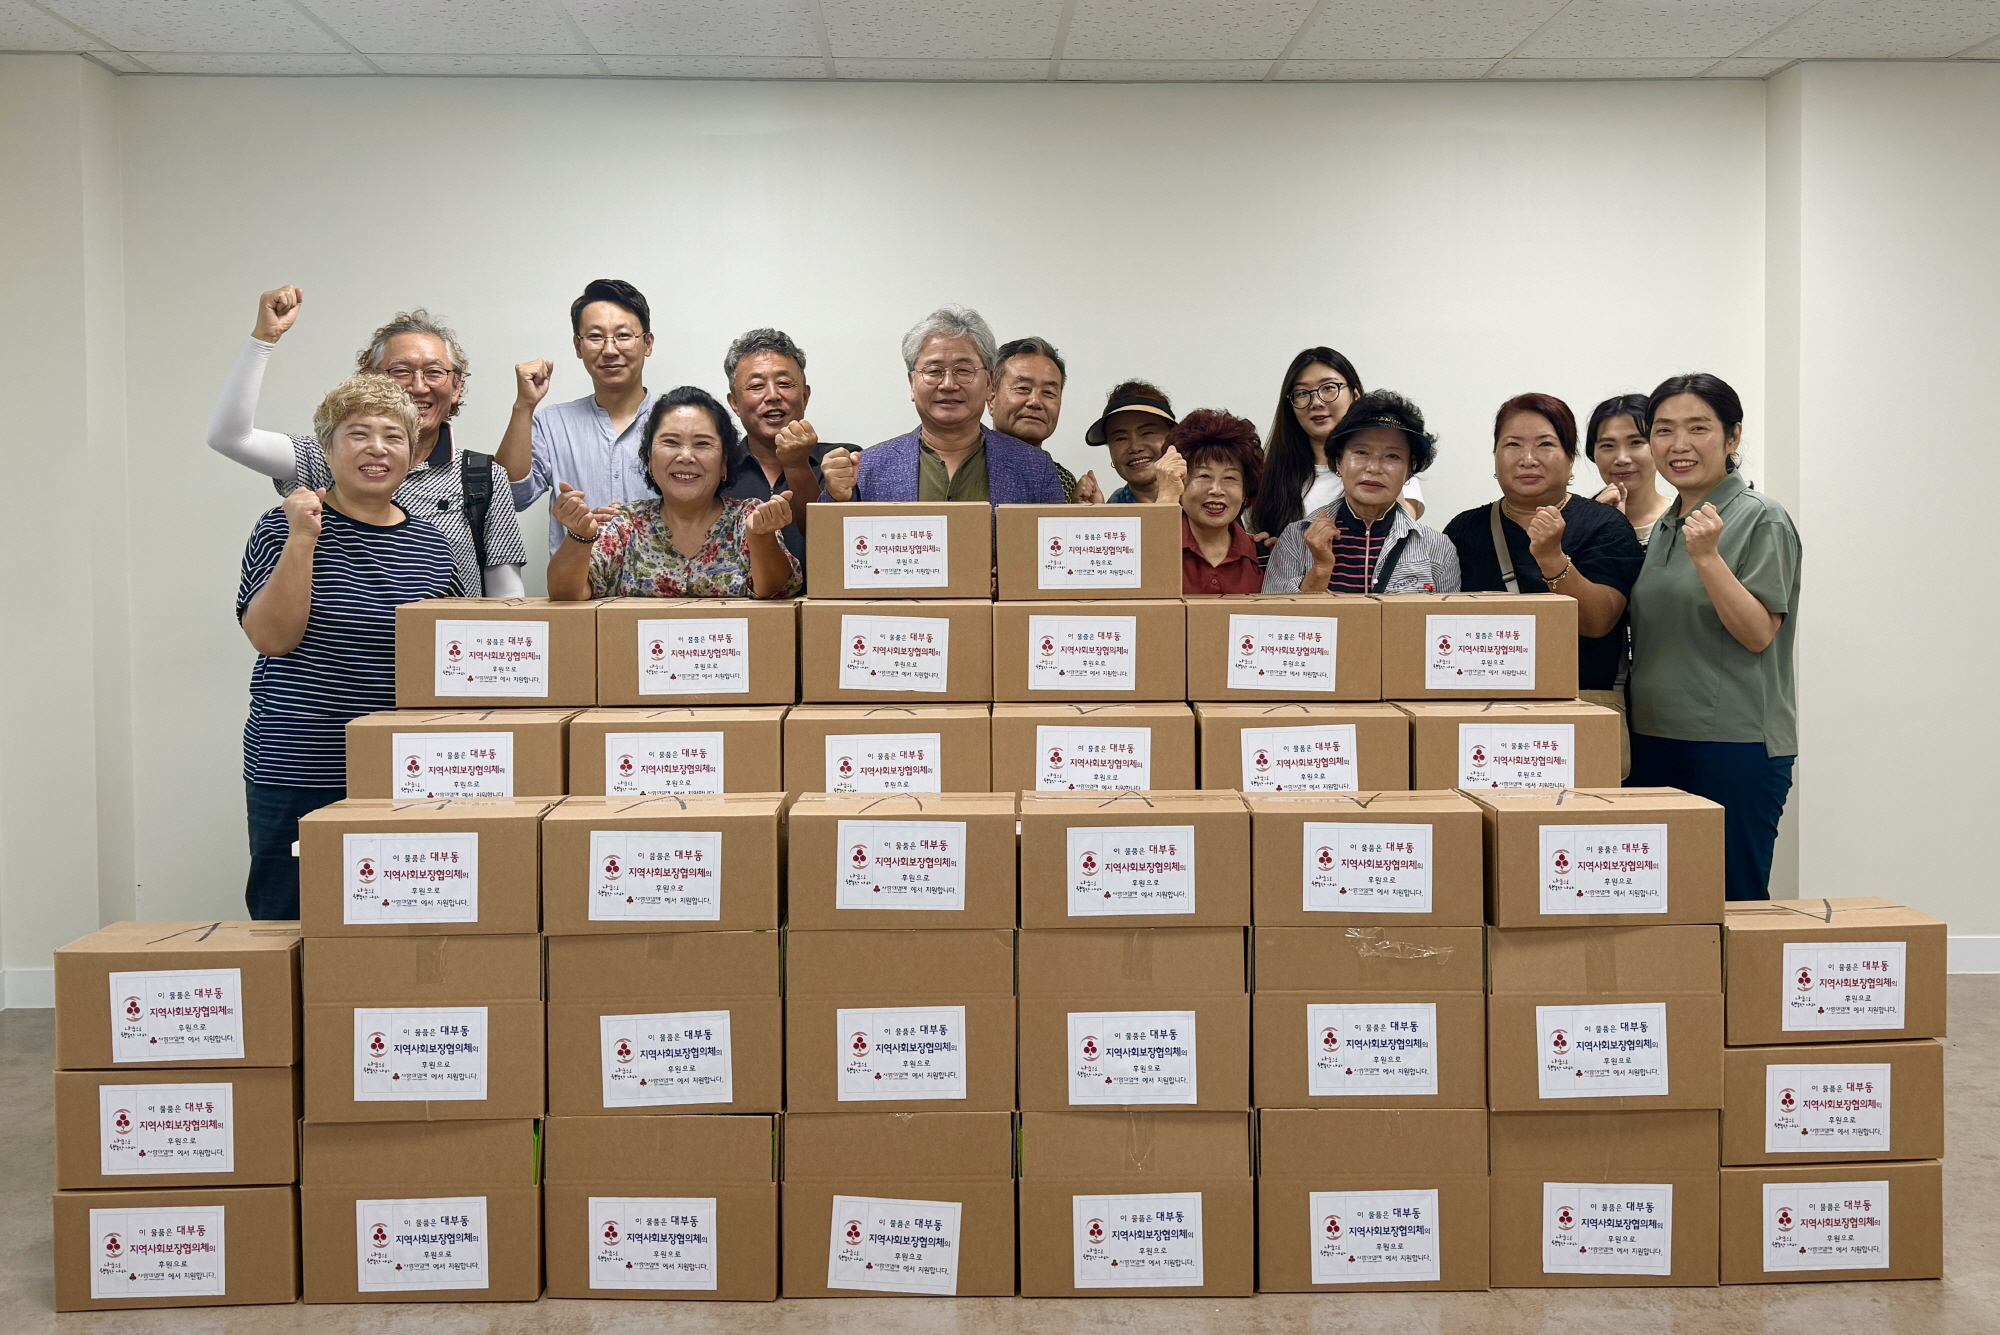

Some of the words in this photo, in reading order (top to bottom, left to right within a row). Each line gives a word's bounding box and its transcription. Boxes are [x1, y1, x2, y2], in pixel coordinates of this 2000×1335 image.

[910, 530, 934, 540] 대부동
[1103, 531, 1127, 541] 대부동
[874, 544, 941, 555] 지역사회보장협의체의
[1068, 545, 1134, 556] 지역사회보장협의체의
[895, 558, 920, 566] 후원으로
[1089, 559, 1113, 567] 후원으로
[507, 636, 533, 647] 대부동
[708, 633, 733, 644] 대부동
[909, 632, 934, 643] 대부동
[1097, 631, 1122, 642] 대부동
[1298, 631, 1323, 642] 대부동
[1495, 630, 1521, 641] 대부동
[468, 650, 541, 662] 지역사회보장협의체의
[670, 648, 741, 660] 지역사회보장협의체의
[871, 646, 941, 658] 지역사회보장협의체의
[1060, 645, 1129, 656] 지역사회보장협의체의
[1260, 645, 1330, 657] 지역사회보장협의체의
[1457, 644, 1529, 656] 지역사회보장협의체의
[693, 662, 719, 671] 후원으로
[893, 660, 918, 669] 후원으로
[1082, 660, 1106, 668] 후원으로
[1281, 660, 1306, 668] 후원으로
[1480, 659, 1505, 667] 후원으로
[491, 666, 517, 674] 후원으로
[1109, 743, 1135, 754] 대부동
[1314, 741, 1341, 752] 대부동
[1532, 740, 1559, 751] 대부동
[469, 748, 497, 760] 대부동
[681, 748, 708, 759] 대부동
[899, 749, 925, 761] 대부동
[1069, 758, 1143, 770] 지역사회보장협의체의
[1275, 756, 1350, 770] 지역사회보장협의체의
[1492, 755, 1567, 767] 지역사회보장협의체의
[428, 764, 506, 777] 지역사회보장협의체의
[640, 763, 716, 776] 지역사회보장협의체의
[859, 765, 933, 777] 지역사회보장협의체의
[1516, 771, 1543, 779] 후원으로
[1093, 773, 1119, 782] 후원으로
[1300, 772, 1326, 781] 후원으로
[453, 780, 480, 789] 후원으로
[665, 779, 692, 788] 후원으로
[884, 780, 910, 789] 후원으로
[919, 839, 949, 852] 대부동
[1148, 844, 1178, 856] 대부동
[1349, 843, 1357, 851] 이
[1361, 843, 1383, 853] 물품은
[1385, 841, 1415, 854] 대부동
[1621, 842, 1650, 855] 대부동
[392, 854, 400, 862] 이
[404, 853, 427, 863] 물품은
[429, 851, 460, 864] 대부동
[674, 849, 704, 862] 대부동
[874, 856, 957, 869] 지역사회보장협의체의
[1104, 861, 1187, 875] 지역사회보장협의체의
[1340, 858, 1424, 872] 지역사회보장협의체의
[1577, 859, 1659, 873] 지역사회보장협의체의
[383, 869, 469, 882] 지역사회보장협의체의
[628, 866, 712, 880] 지역사회보장협의체의
[900, 873, 931, 883] 후원으로
[1131, 879, 1160, 888] 후원으로
[1367, 876, 1397, 885] 후원으로
[1604, 877, 1633, 887] 후원으로
[410, 887, 441, 896] 후원으로
[655, 884, 685, 894] 후원으로
[1376, 888, 1390, 896] 에서
[420, 899, 434, 907] 에서
[1862, 960, 1889, 972] 대부동
[1818, 977, 1898, 990] 지역사회보장협의체의
[168, 990, 191, 1001] 물품은
[194, 987, 224, 1000] 대부동
[1844, 994, 1872, 1004] 후원으로
[149, 1005, 234, 1019] 지역사회보장협의체의
[177, 1023, 207, 1033] 후원으로
[440, 1025, 470, 1038] 대부동
[919, 1024, 949, 1037] 대부동
[1365, 1023, 1387, 1033] 물품은
[1389, 1020, 1419, 1033] 대부동
[1620, 1021, 1649, 1033] 대부동
[683, 1028, 713, 1041] 대부동
[1149, 1028, 1178, 1041] 대부동
[393, 1041, 479, 1056] 지역사회보장협의체의
[875, 1041, 958, 1056] 지역사회보장협의체의
[1345, 1036, 1429, 1051] 지역사회보장협의체의
[1575, 1038, 1659, 1053] 지역사회보장협의체의
[639, 1046, 723, 1061] 지역사회보장협의체의
[1105, 1045, 1188, 1060] 지역사회보장협의체의
[421, 1060, 451, 1070] 후원으로
[901, 1059, 931, 1069] 후원으로
[1372, 1055, 1402, 1065] 후원으로
[1603, 1056, 1632, 1066] 후원으로
[667, 1064, 697, 1074] 후원으로
[1132, 1064, 1161, 1074] 후원으로
[1382, 1068, 1395, 1076] 에서
[1846, 1081, 1874, 1094] 대부동
[184, 1101, 215, 1114] 대부동
[1802, 1099, 1882, 1111] 지역사회보장협의체의
[139, 1119, 224, 1133] 지역사회보장협의체의
[1828, 1116, 1857, 1125] 후원으로
[166, 1137, 197, 1146] 후원으로
[1625, 1201, 1655, 1214] 대부동
[1808, 1203, 1816, 1211] 이
[1819, 1202, 1841, 1212] 물품은
[1843, 1199, 1872, 1211] 대부동
[1155, 1211, 1185, 1224] 대부동
[1392, 1207, 1422, 1220] 대부동
[415, 1218, 437, 1228] 물품은
[440, 1215, 470, 1227] 대부동
[670, 1215, 699, 1228] 대부동
[914, 1218, 943, 1232] 대부동
[1580, 1217, 1664, 1231] 지역사회보장협의체의
[1800, 1216, 1881, 1230] 지역사회보장협의체의
[176, 1224, 207, 1237] 대부동
[1111, 1228, 1194, 1242] 지역사회보장협의체의
[1348, 1224, 1431, 1238] 지역사회보장협의체의
[395, 1232, 479, 1247] 지역사회보장협의체의
[626, 1232, 708, 1246] 지역사회보장협의체의
[868, 1233, 951, 1249] 지역사회보장협의체의
[1607, 1235, 1637, 1244] 후원으로
[1826, 1234, 1855, 1243] 후원으로
[129, 1242, 216, 1256] 지역사회보장협의체의
[1138, 1247, 1168, 1256] 후원으로
[1375, 1242, 1405, 1252] 후원으로
[1835, 1246, 1848, 1254] 에서
[423, 1250, 453, 1260] 후원으로
[652, 1250, 682, 1259] 후원으로
[893, 1252, 923, 1262] 후원으로
[158, 1260, 188, 1270] 후원으로
